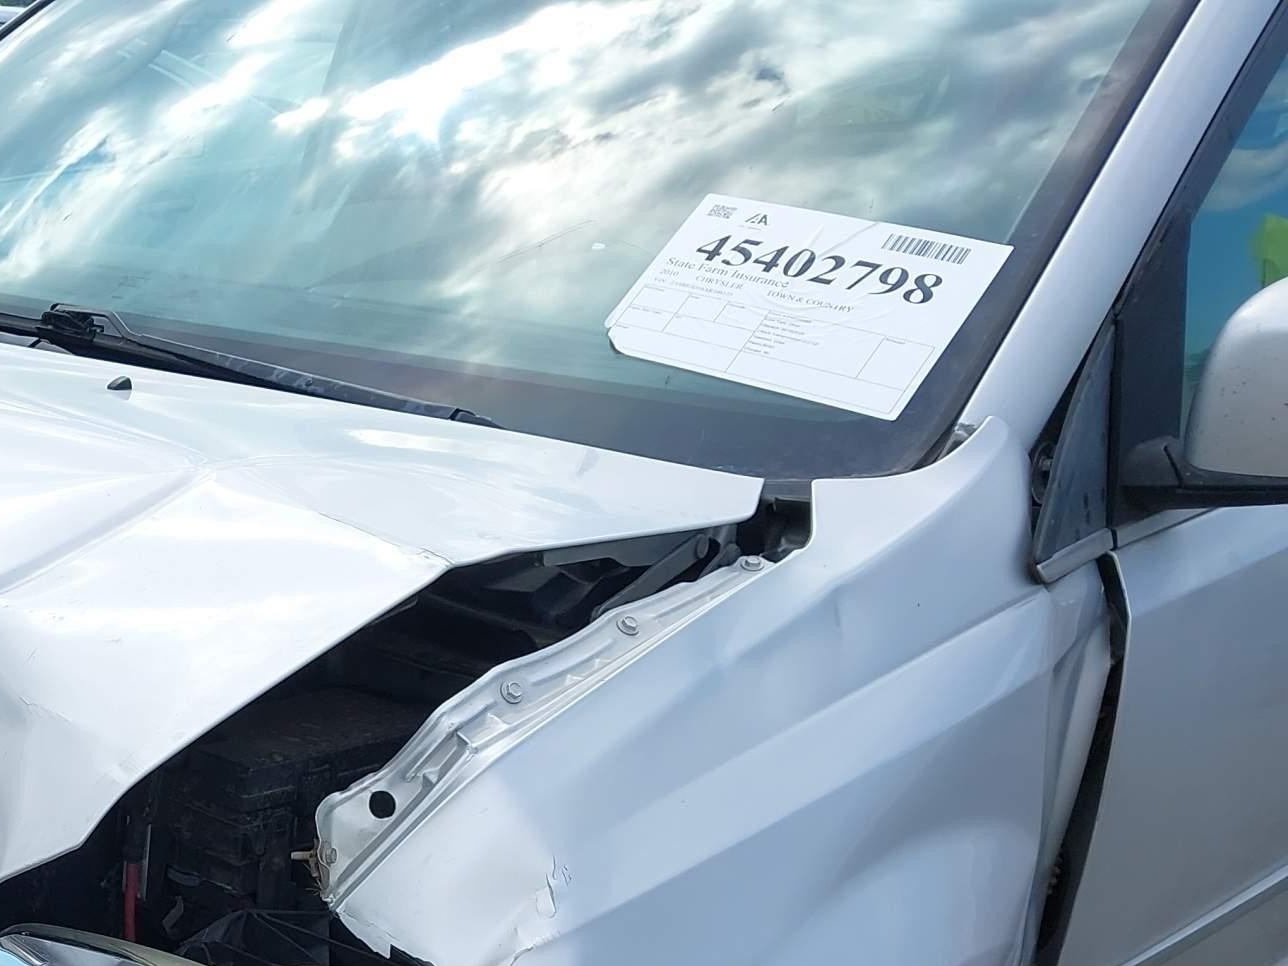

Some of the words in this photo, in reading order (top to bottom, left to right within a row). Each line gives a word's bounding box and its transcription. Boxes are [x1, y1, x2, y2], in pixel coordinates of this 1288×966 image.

[666, 256, 696, 270] State
[697, 262, 729, 276] Farm
[731, 269, 789, 288] Insurance
[696, 234, 943, 305] 45402798
[695, 275, 745, 290] CHRYSLER
[766, 290, 795, 301] TOWN
[805, 298, 855, 313] COUNTRY
